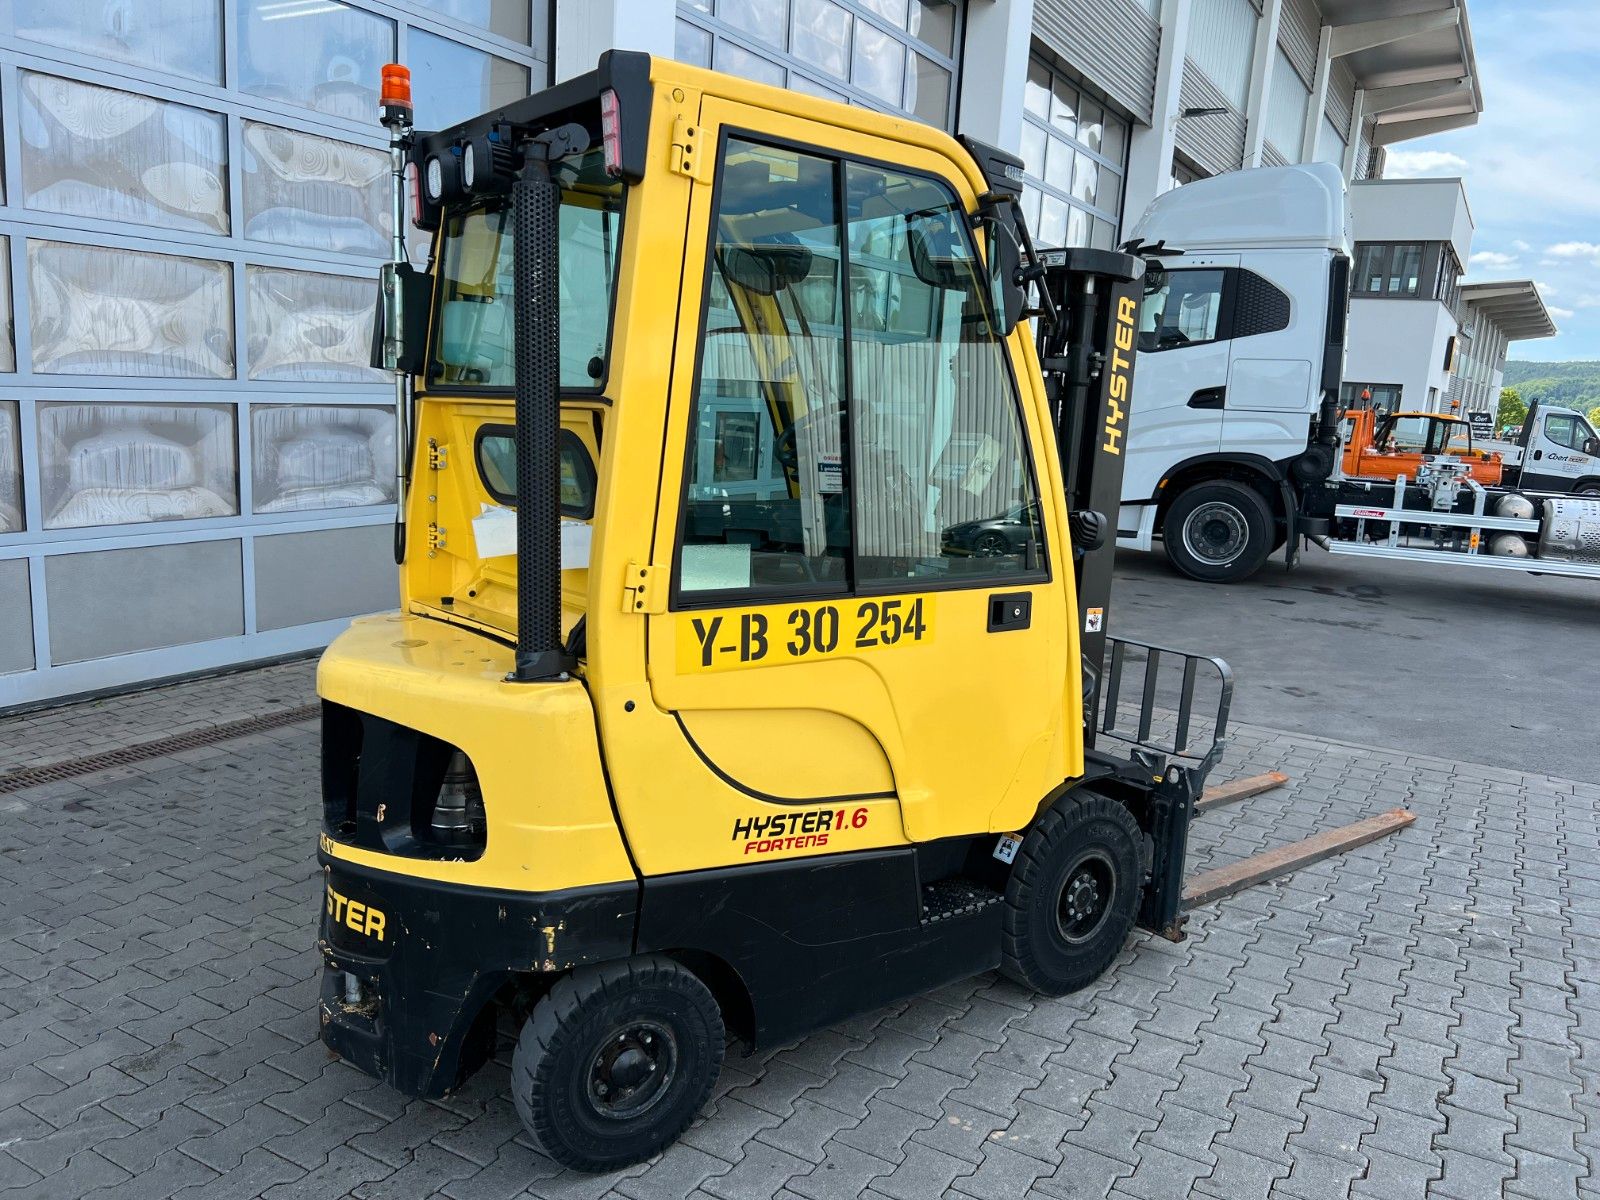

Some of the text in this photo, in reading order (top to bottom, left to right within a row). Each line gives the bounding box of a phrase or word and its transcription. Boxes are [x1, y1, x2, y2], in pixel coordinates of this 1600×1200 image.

[1103, 296, 1136, 456] HYSTER
[691, 598, 927, 667] Y-B 30 254
[732, 808, 869, 841] HYSTER 1.6
[744, 834, 829, 854] FORTENS
